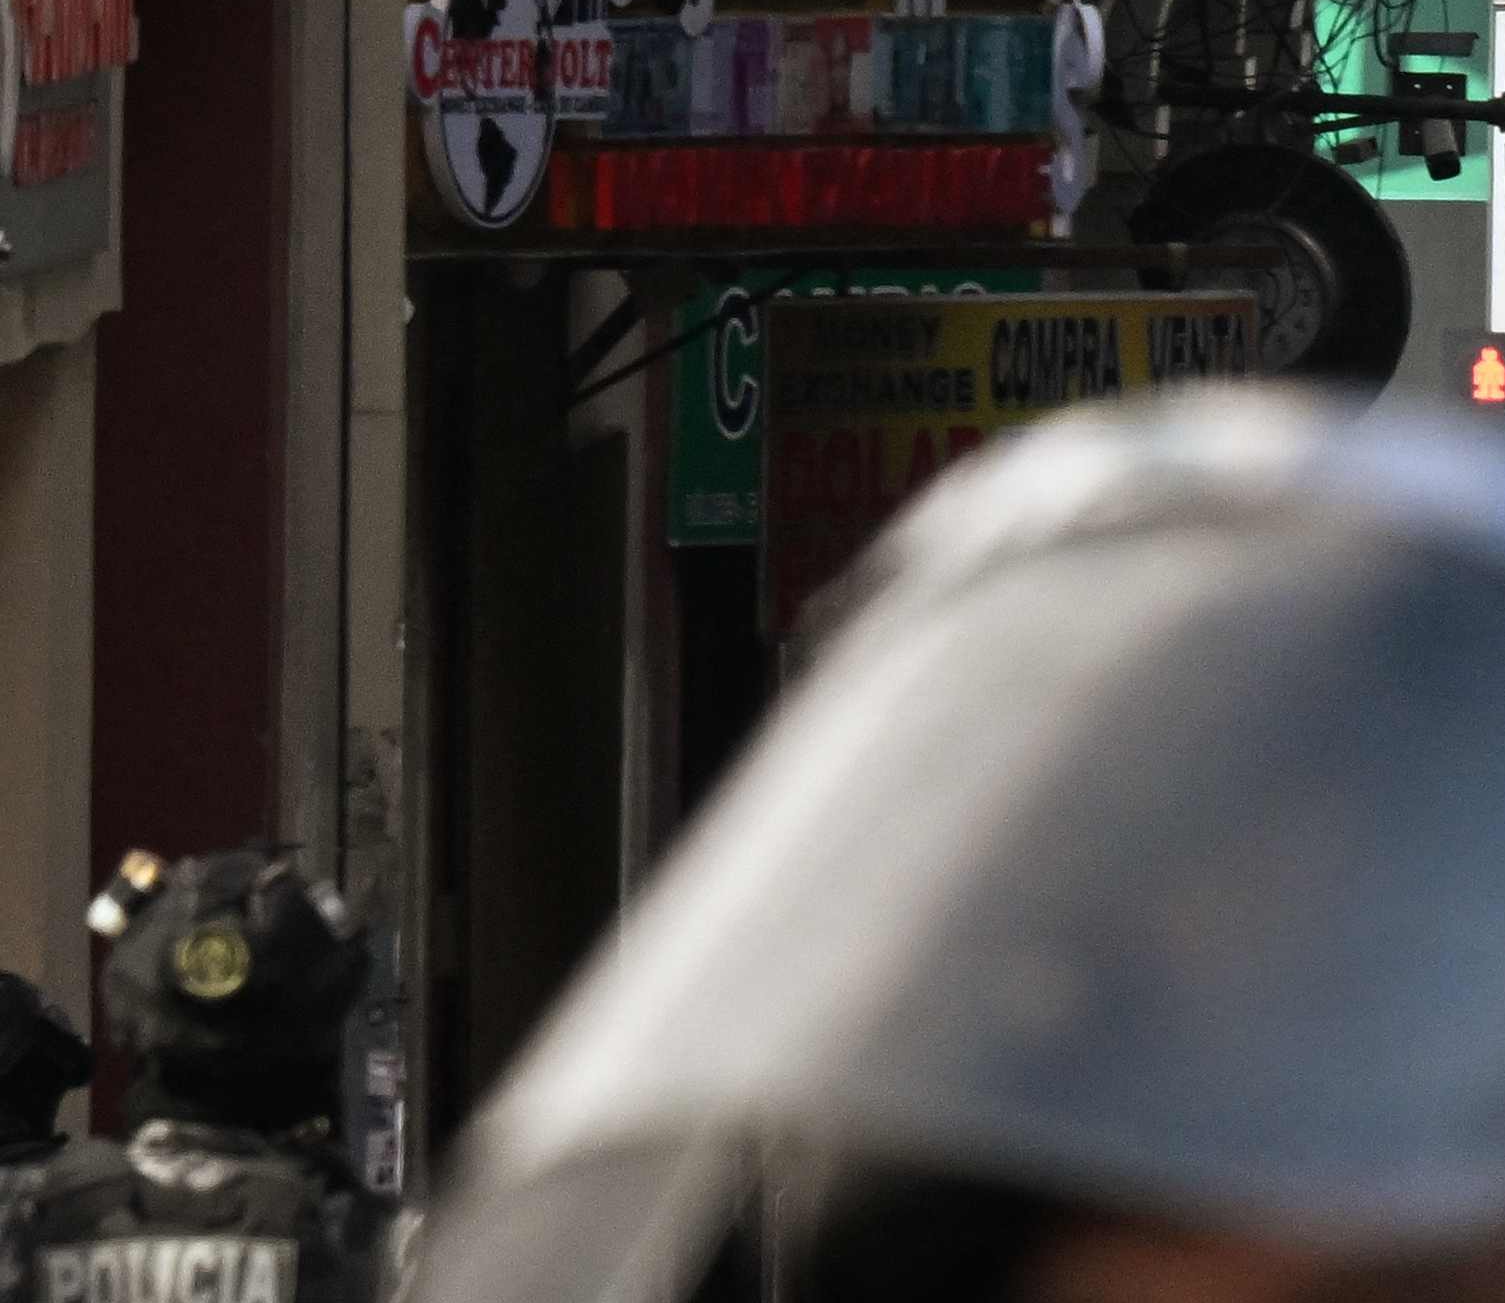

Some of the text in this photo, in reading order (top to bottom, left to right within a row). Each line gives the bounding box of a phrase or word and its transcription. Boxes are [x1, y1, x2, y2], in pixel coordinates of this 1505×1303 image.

[781, 368, 977, 412] EXCHANGE
[990, 316, 1122, 410] COMPRA
[1147, 313, 1247, 388] VENTA
